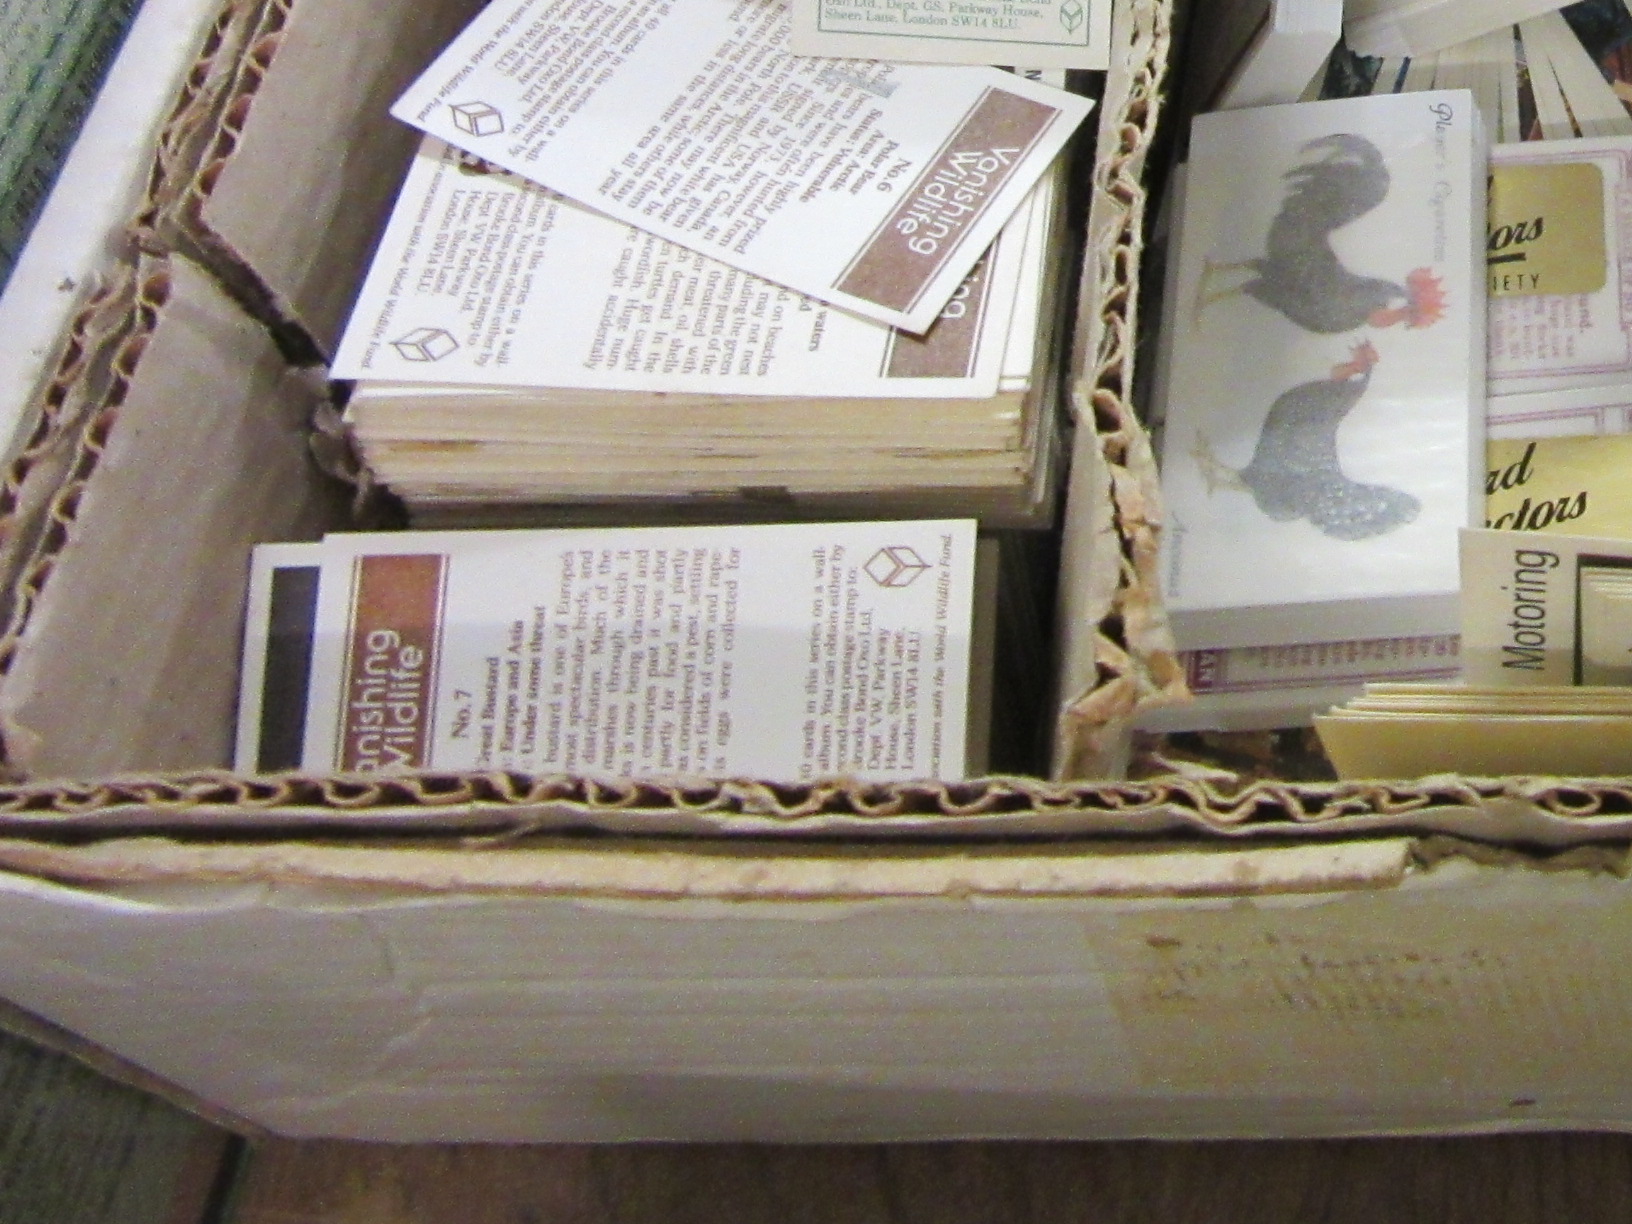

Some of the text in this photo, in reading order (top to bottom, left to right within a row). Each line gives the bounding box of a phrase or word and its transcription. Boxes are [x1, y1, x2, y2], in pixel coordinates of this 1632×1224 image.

[436, 61, 474, 100] Wildlife
[469, 37, 498, 66] World
[797, 106, 883, 206] Status: Vulnerable
[828, 129, 886, 195] Area: Arctic
[848, 137, 899, 197] Polar Bear
[717, 177, 781, 250] hunted from
[731, 176, 800, 257] highly prized
[895, 152, 981, 237] Wildlife
[911, 150, 1010, 255] Vanishing
[387, 265, 410, 297] World
[582, 246, 636, 371] caught accidentally
[1491, 274, 1540, 293] IETY
[1486, 442, 1537, 496] rd
[936, 571, 951, 620] Wildlife
[1500, 549, 1560, 670] Motoring
[521, 605, 546, 754] Under some threat
[934, 626, 947, 661] World
[352, 629, 400, 771] anishing
[481, 656, 499, 719] Bustard
[500, 620, 524, 751] Europe and Asia
[544, 701, 562, 762] bustard
[553, 646, 567, 675] one
